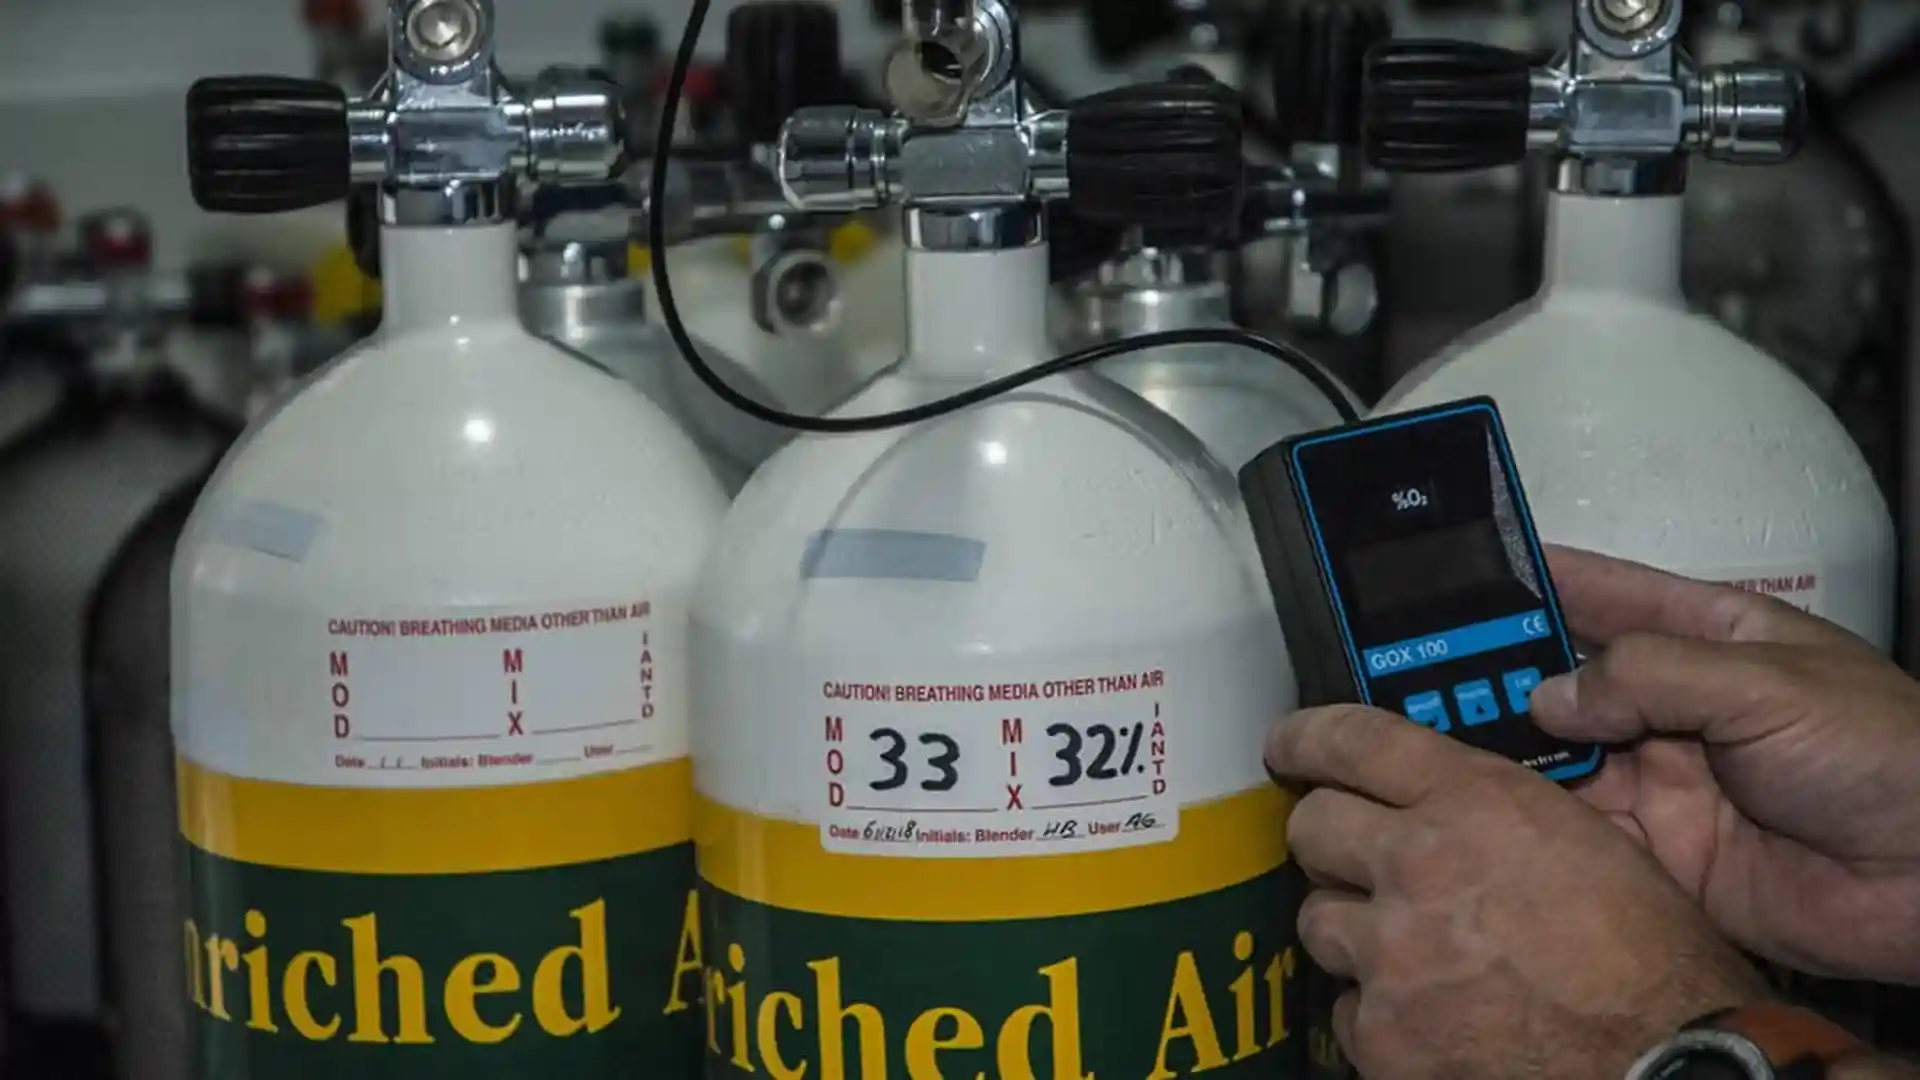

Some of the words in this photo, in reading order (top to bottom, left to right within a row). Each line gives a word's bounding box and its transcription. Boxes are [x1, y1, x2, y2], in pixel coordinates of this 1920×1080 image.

[328, 618, 395, 636] CAUTION!
[400, 616, 487, 637] BREATHING
[490, 614, 538, 633] MEDIA
[541, 609, 589, 630] OTHER
[591, 605, 627, 624] THAN
[630, 600, 650, 618] AIR
[1370, 649, 1413, 671] GOX
[1417, 639, 1448, 660] 100
[329, 651, 350, 739] MOD
[503, 649, 524, 736] MIX
[823, 682, 891, 700] CAUTION!
[895, 685, 984, 702] BREATHING
[989, 683, 1039, 700] MEDIA
[1043, 681, 1095, 699] OTHER
[1098, 675, 1137, 693] THAN
[1140, 670, 1164, 688] AIR
[335, 754, 366, 769] Date
[421, 755, 474, 769] Initials:
[477, 753, 534, 768] Blender
[825, 716, 845, 808] MOD
[868, 727, 961, 791] 33
[1002, 719, 1023, 811] MIX
[1046, 722, 1146, 787] 32%
[829, 824, 859, 840] Date
[916, 828, 972, 843] Initials:
[975, 827, 1034, 843] Blender
[1087, 822, 1121, 835] User
[1145, 931, 1296, 1080] Air
